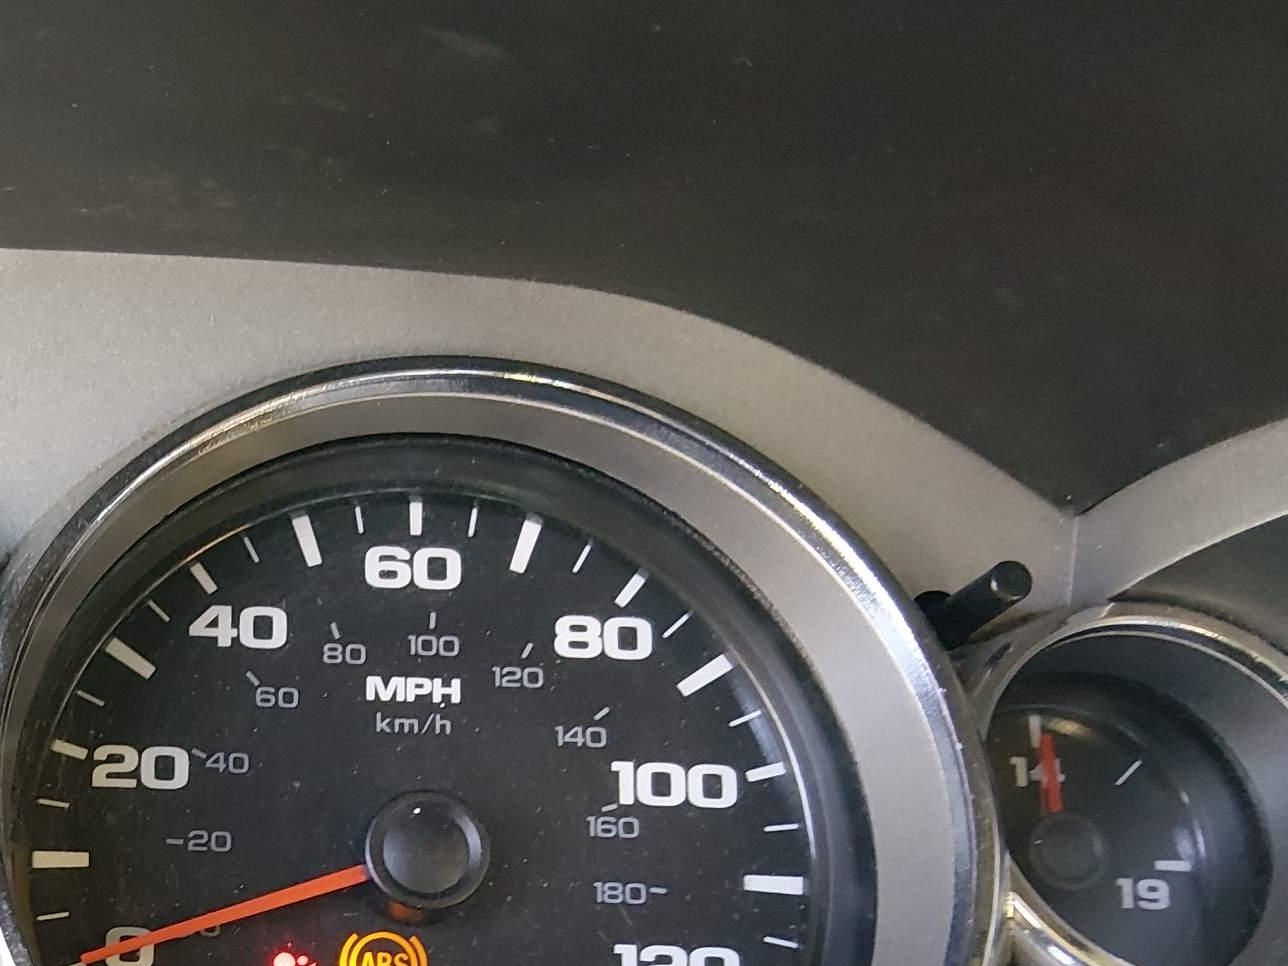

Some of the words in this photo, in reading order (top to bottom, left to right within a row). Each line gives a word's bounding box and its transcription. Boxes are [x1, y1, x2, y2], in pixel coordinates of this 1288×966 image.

[364, 546, 462, 590] 60
[188, 605, 288, 650] 40
[553, 614, 654, 661] 80
[322, 643, 367, 665] 80
[408, 634, 460, 658] 100
[365, 675, 462, 704] MPH
[491, 666, 544, 690] 120
[255, 686, 299, 709] 60
[375, 711, 452, 735] km/h
[555, 725, 608, 749] 140
[91, 744, 190, 790] 20
[205, 751, 250, 774] 40
[611, 760, 738, 809] 100
[585, 815, 640, 840] 160
[187, 830, 232, 853] 20
[593, 881, 647, 905] 180
[1115, 877, 1171, 911] 19
